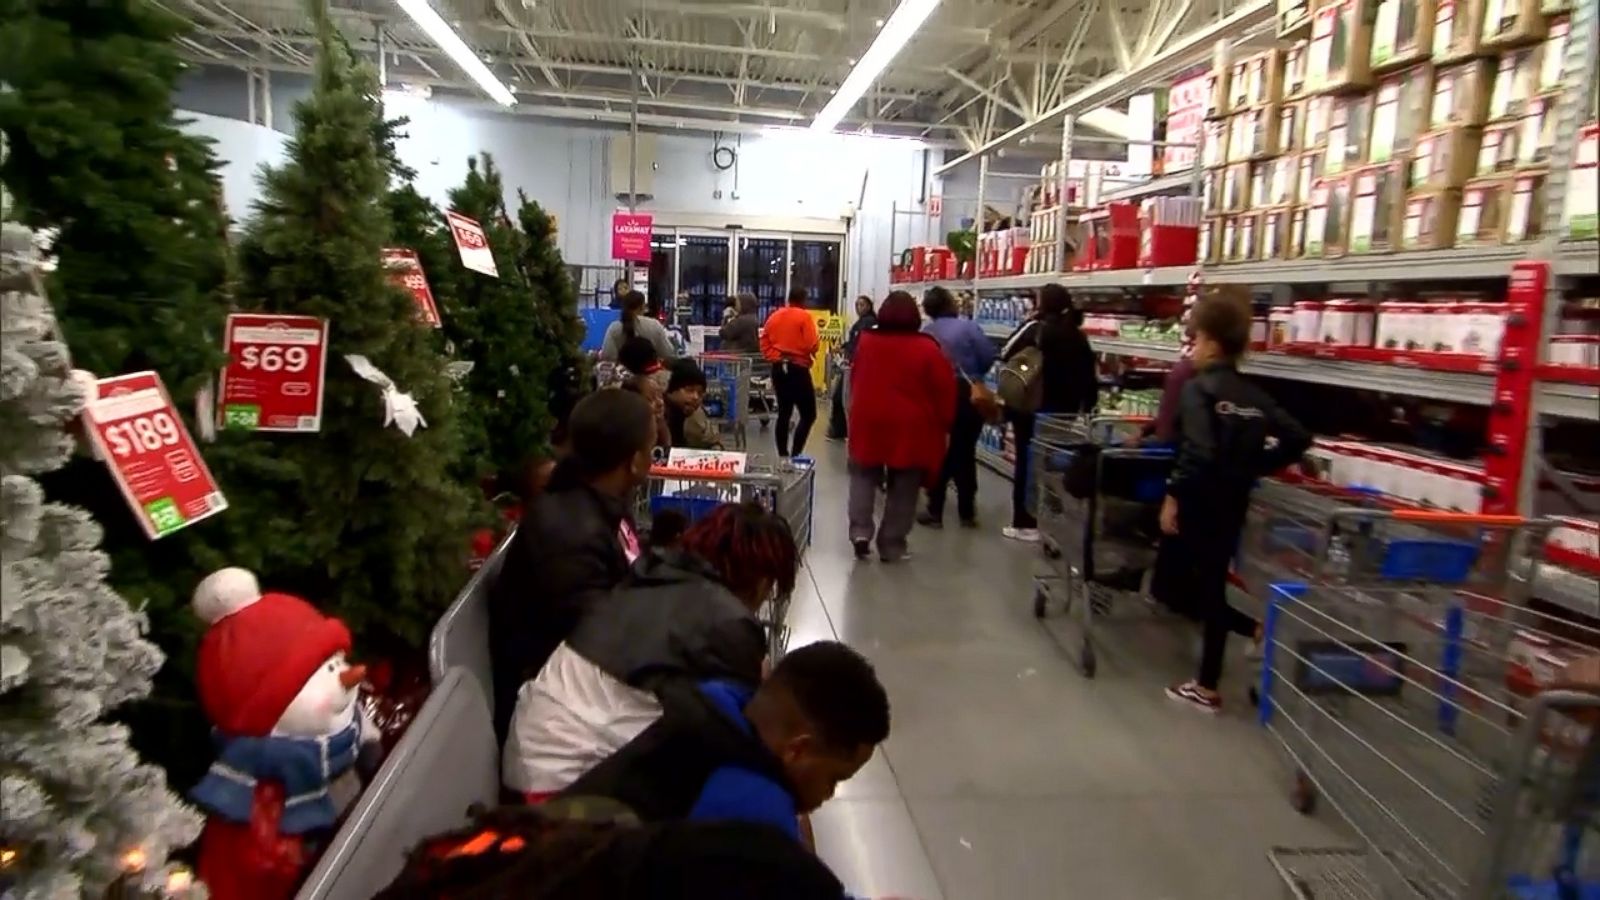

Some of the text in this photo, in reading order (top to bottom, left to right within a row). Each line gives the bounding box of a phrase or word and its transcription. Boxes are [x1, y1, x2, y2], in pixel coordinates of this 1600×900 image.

[615, 225, 650, 235] LAYAWAY
[239, 345, 309, 373] $69
[105, 412, 180, 458] $189
